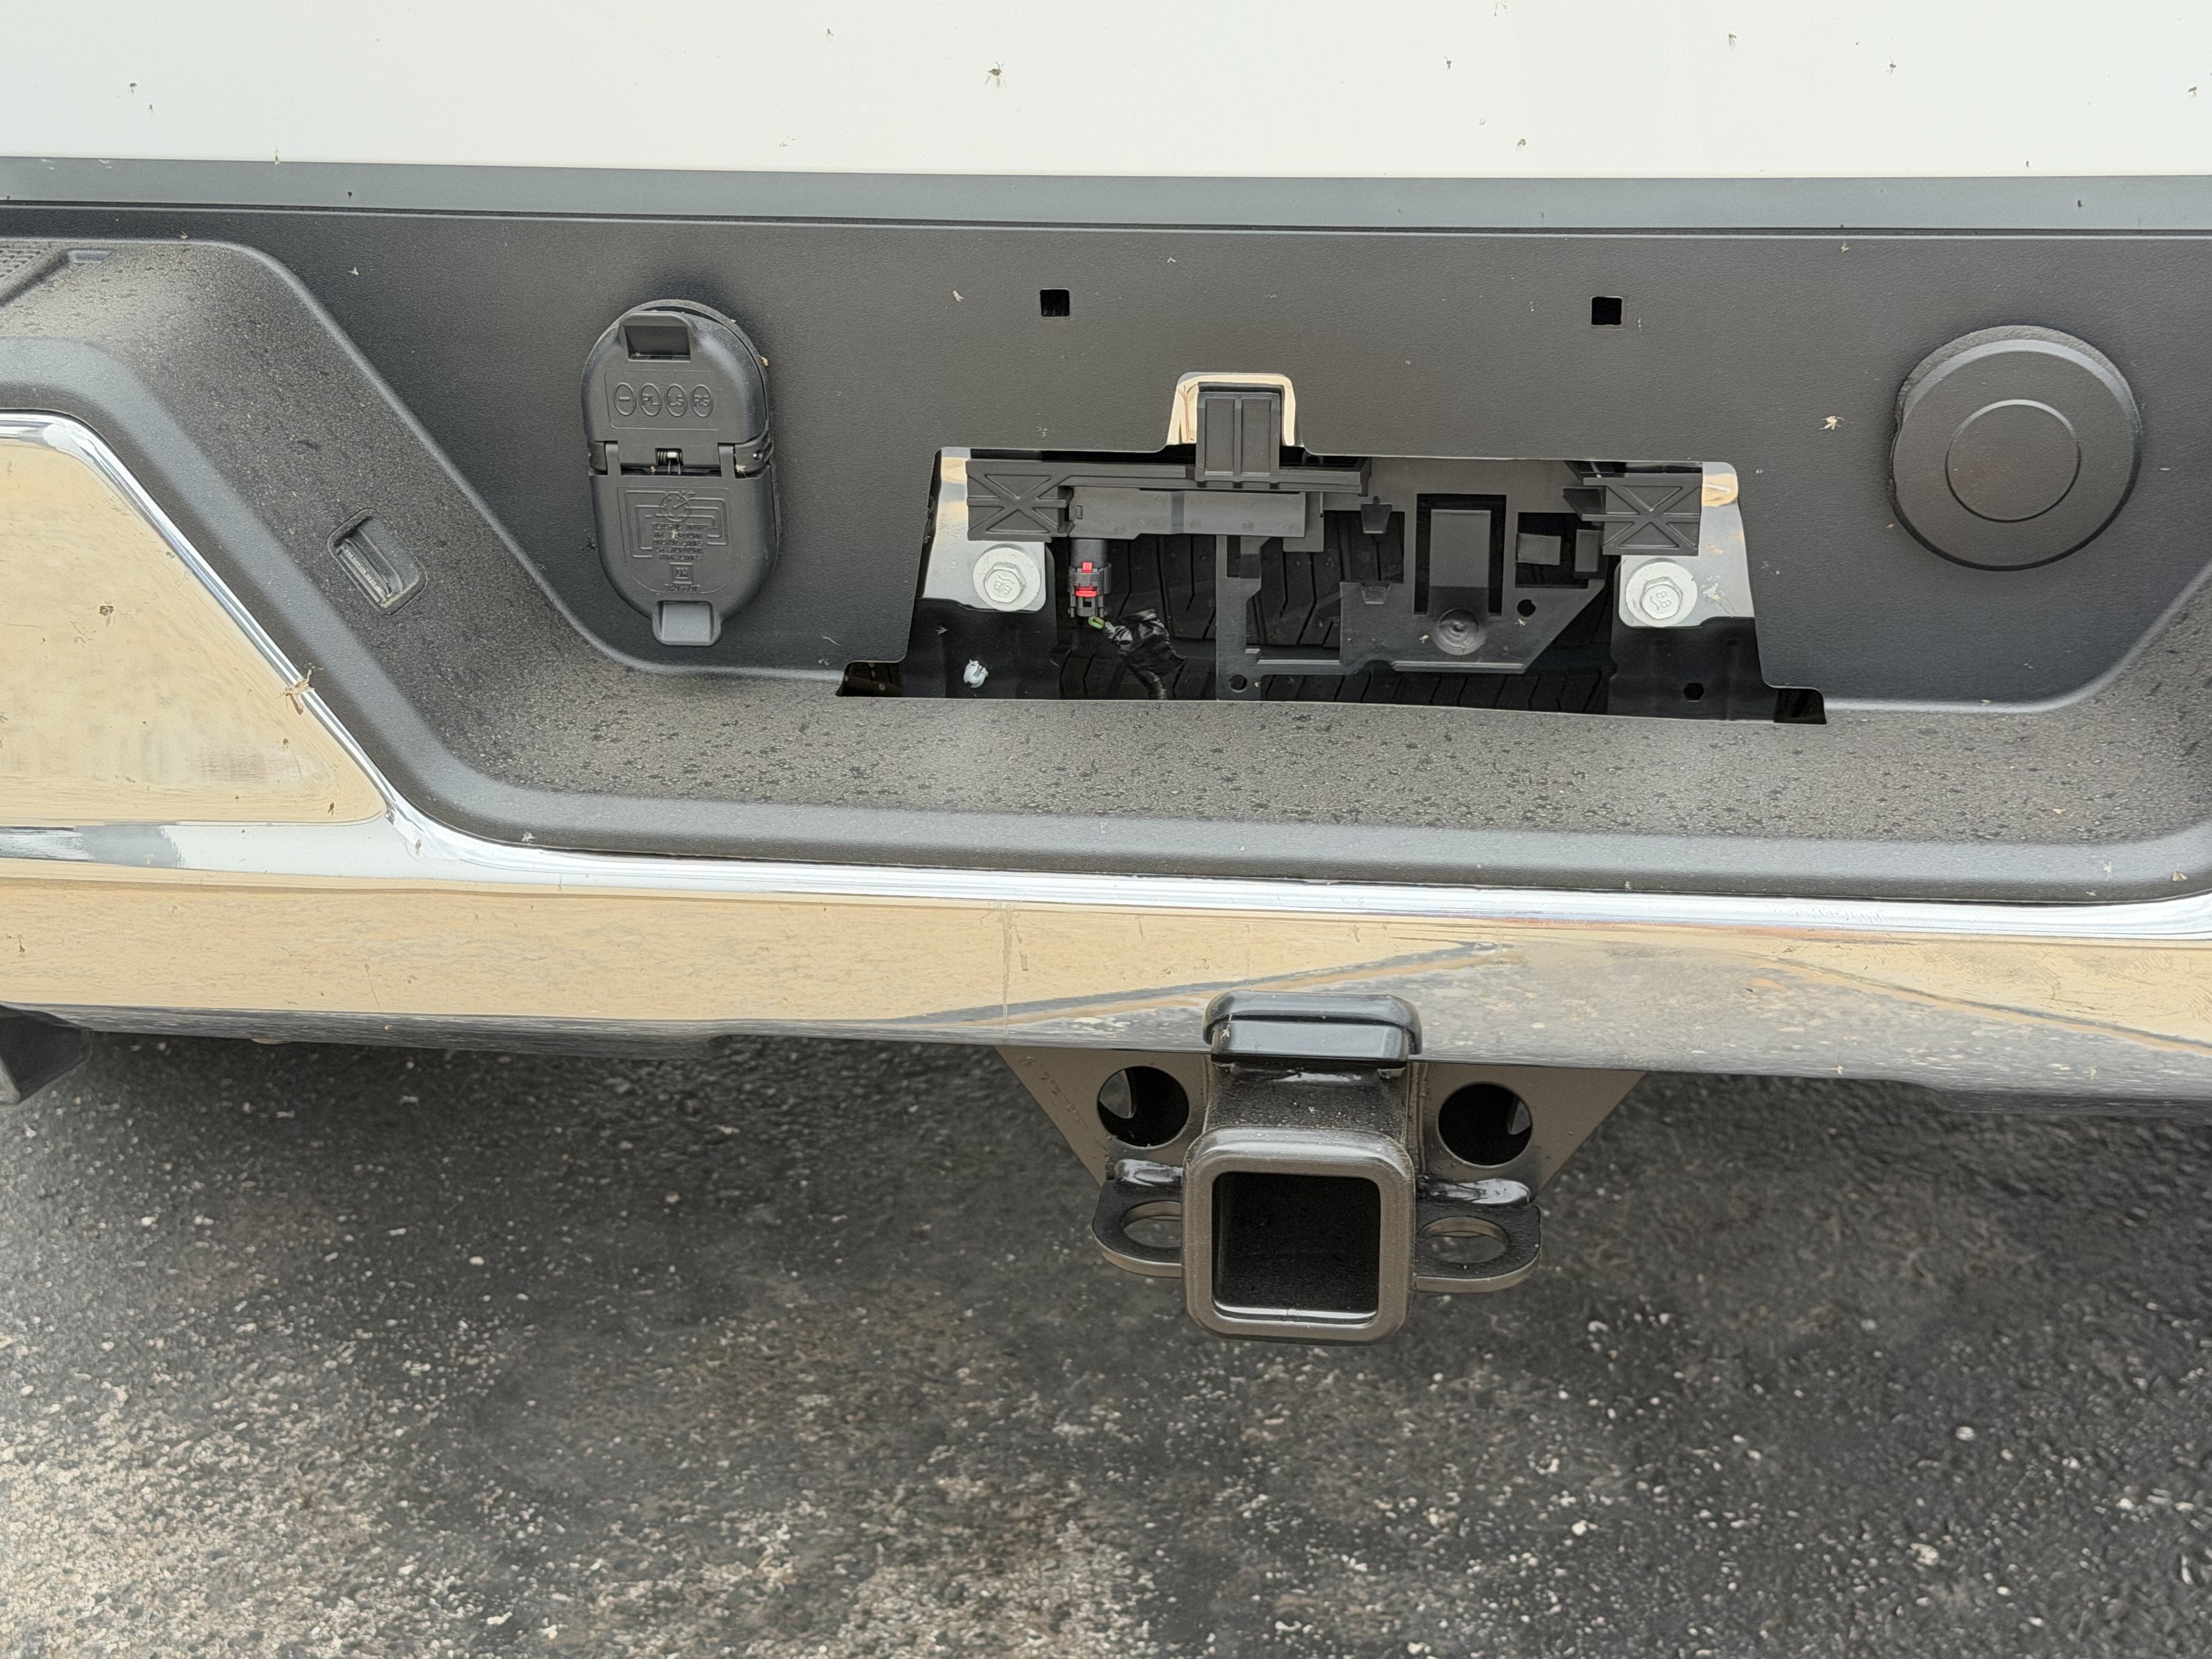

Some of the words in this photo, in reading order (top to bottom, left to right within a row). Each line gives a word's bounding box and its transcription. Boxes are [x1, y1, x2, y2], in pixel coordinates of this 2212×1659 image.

[641, 393, 659, 406] PL
[667, 394, 684, 407] LS
[693, 395, 710, 407] RS
